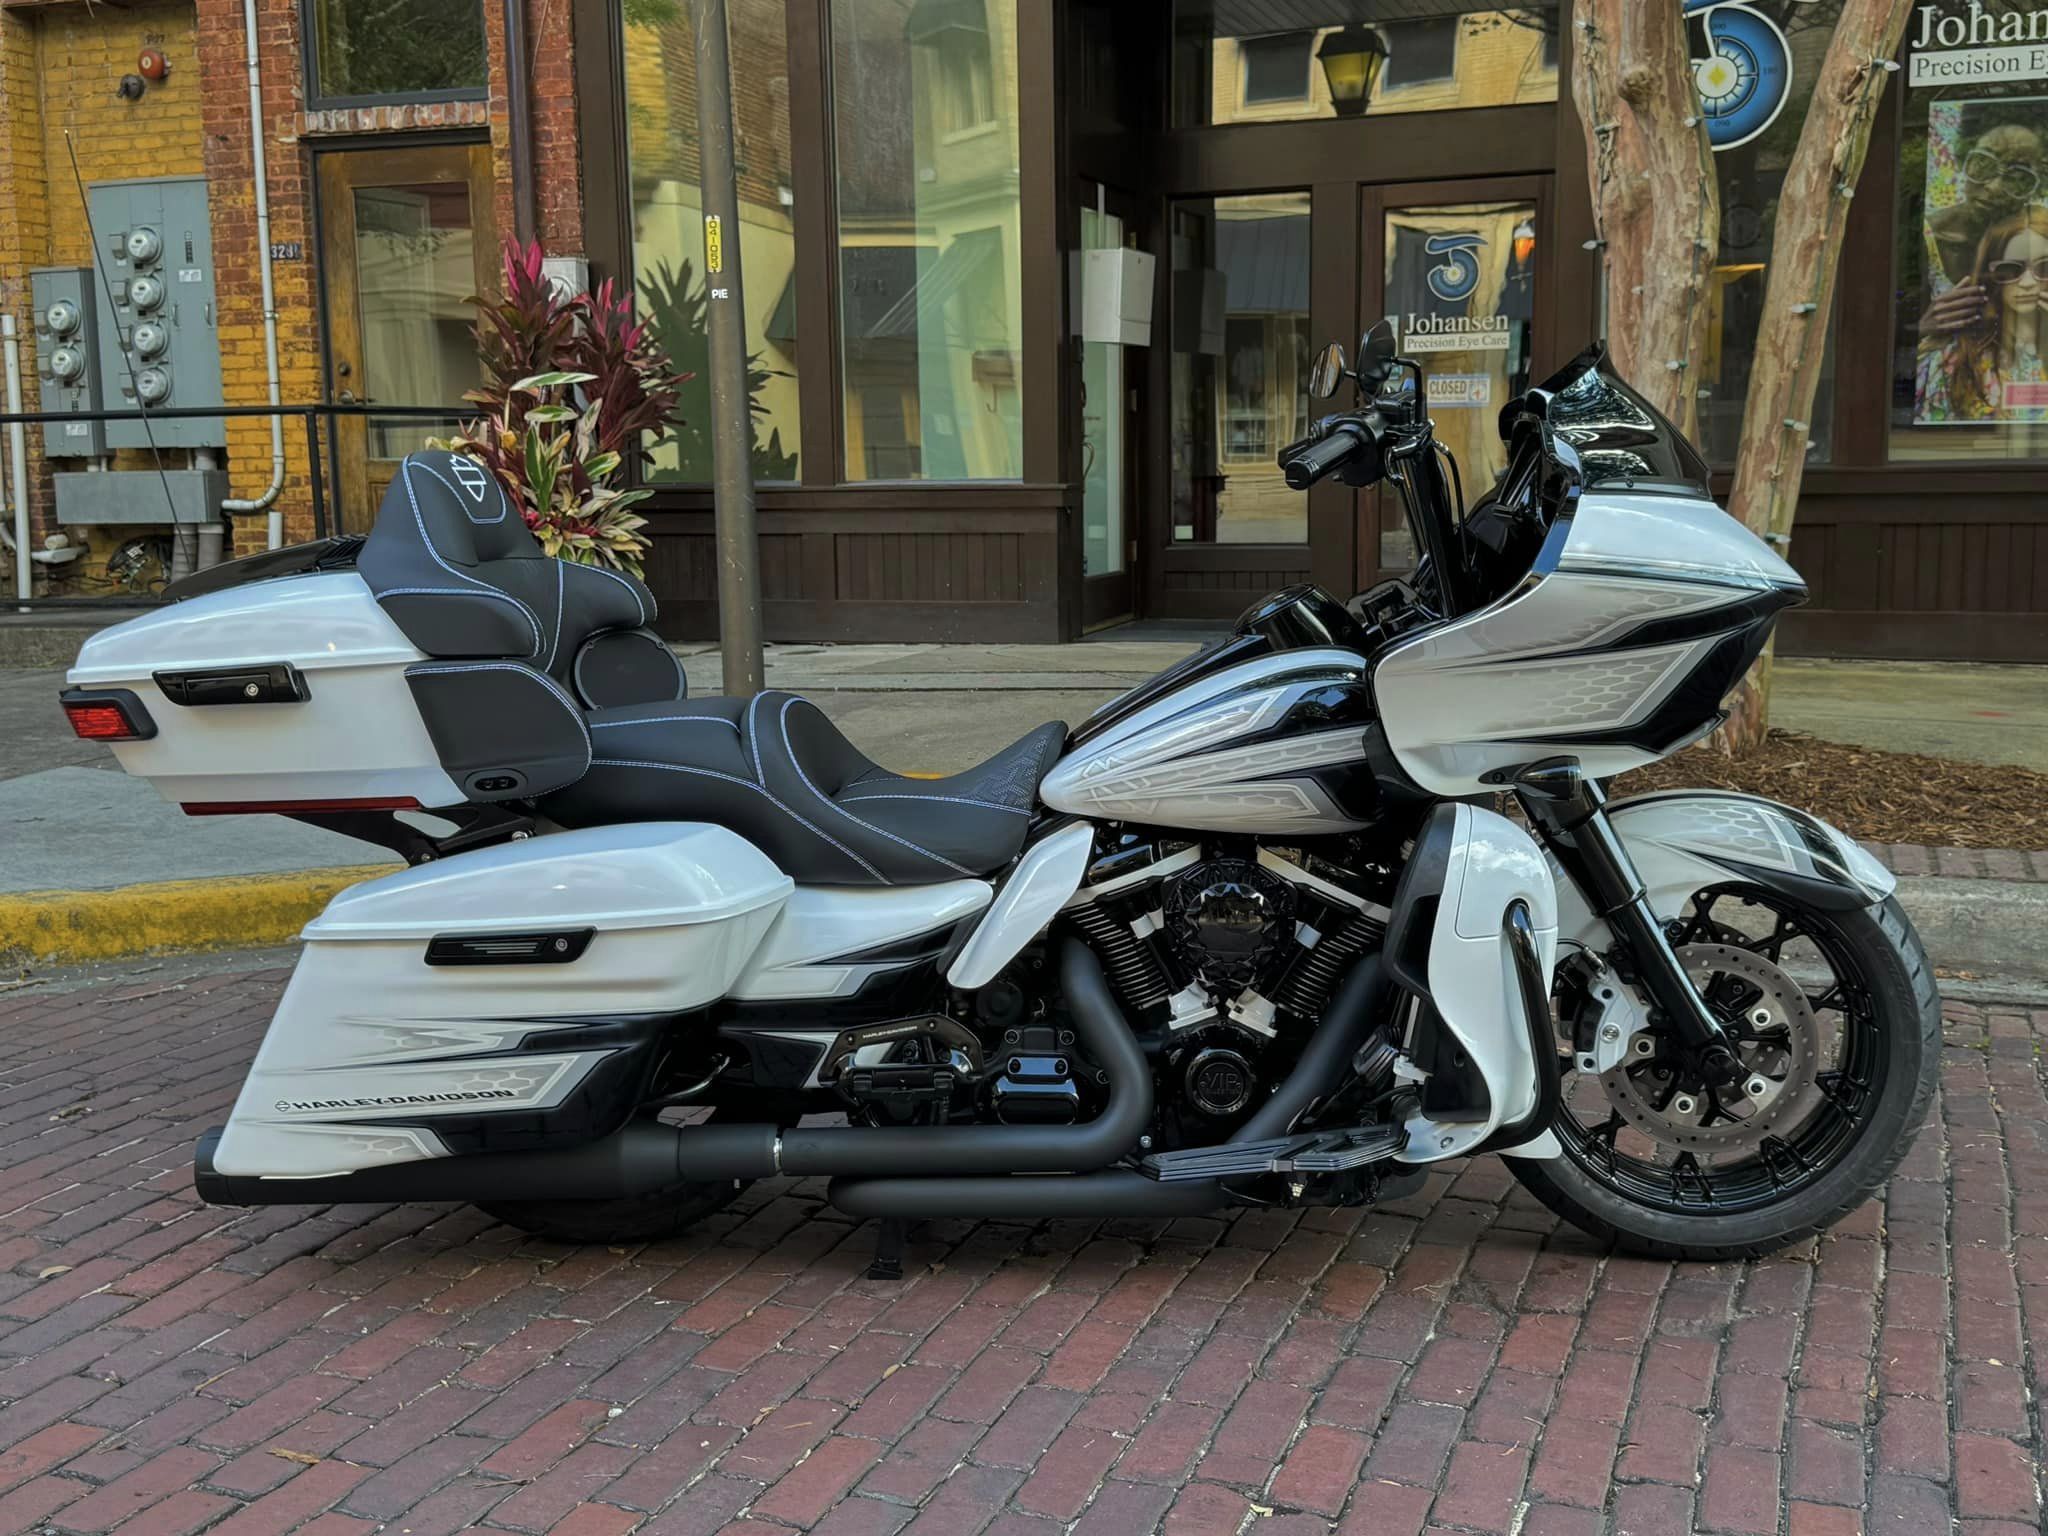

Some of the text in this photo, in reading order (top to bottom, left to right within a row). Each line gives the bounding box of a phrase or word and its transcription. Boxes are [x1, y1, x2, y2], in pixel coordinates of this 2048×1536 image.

[1915, 50, 2048, 78] Precision E
[711, 288, 728, 299] PIE
[1405, 312, 1509, 334] Johansen
[1407, 334, 1507, 349] Precision Eye Care
[1429, 380, 1467, 394] CLOSED
[293, 1089, 514, 1109] HARLEY-DAVIDSON
